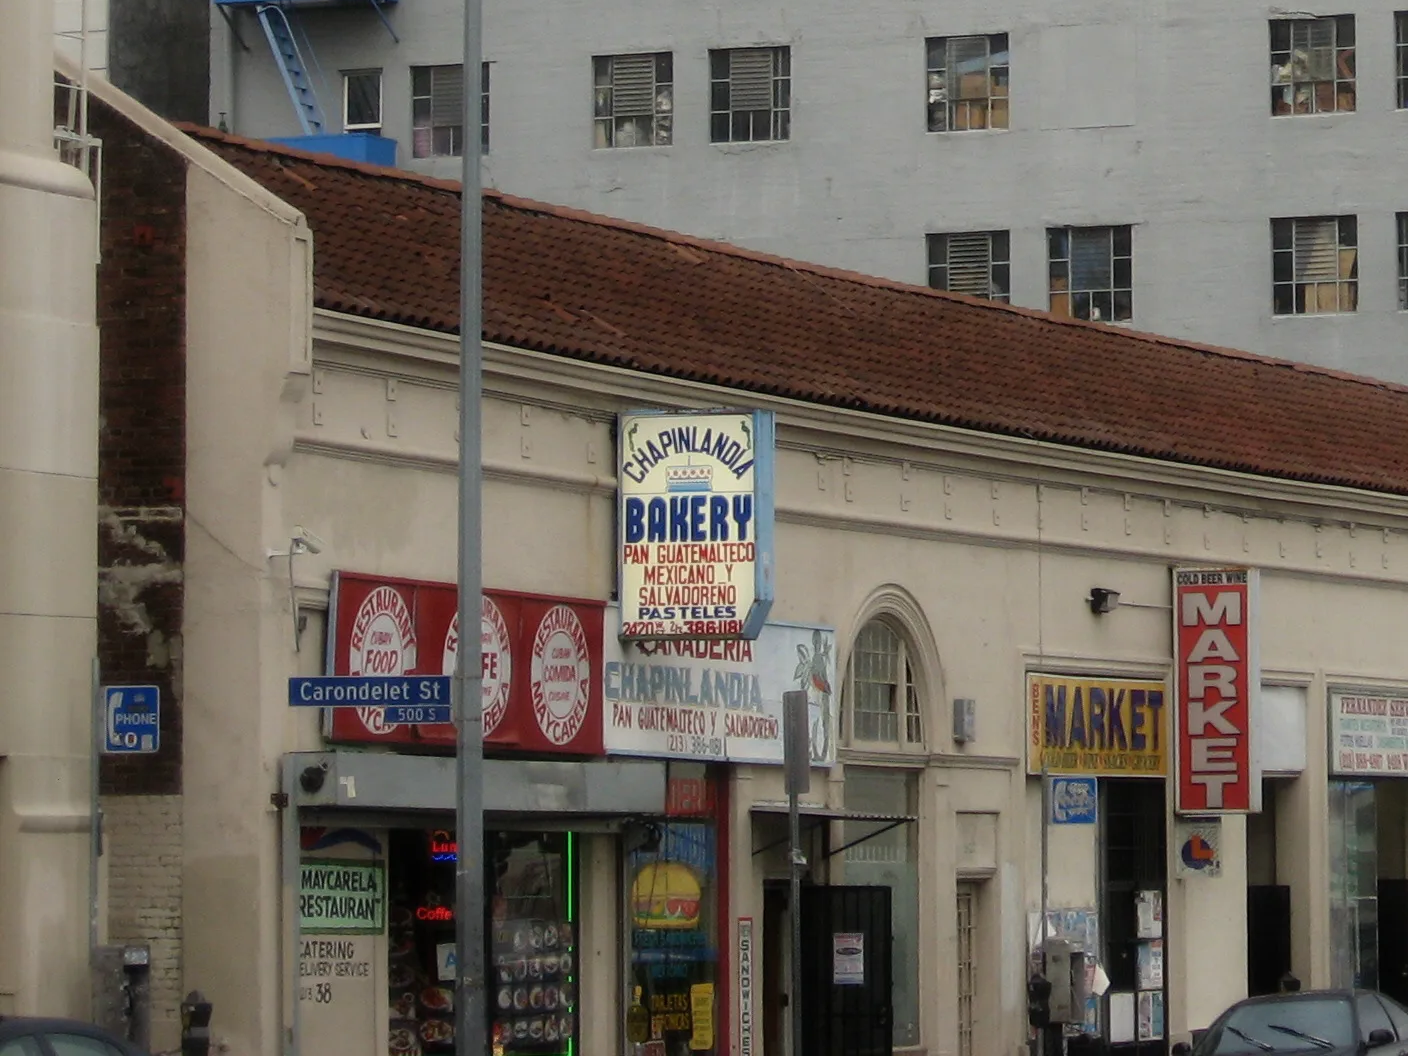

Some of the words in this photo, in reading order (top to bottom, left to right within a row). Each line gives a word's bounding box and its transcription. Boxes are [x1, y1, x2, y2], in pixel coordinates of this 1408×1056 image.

[625, 494, 752, 544] BAKERY
[623, 544, 649, 564] PAN
[657, 542, 755, 563] GUATEMALTECO
[644, 565, 715, 585] MEXICANO
[1177, 572, 1199, 585] COLD
[1201, 572, 1223, 585] BEER
[1226, 571, 1247, 584] WINE
[352, 587, 417, 653] RESTAURANT
[638, 606, 736, 619] PASTELES
[534, 607, 588, 662] RESTAURANT
[623, 622, 653, 636] 2420
[365, 649, 398, 675] FOOD
[300, 681, 410, 701] Carondelet
[419, 682, 440, 700] St
[1181, 592, 1241, 808] MARKET
[115, 713, 157, 725] PHONE
[398, 707, 424, 721] 500
[428, 707, 436, 721] S
[532, 678, 589, 742] MAYCARELA
[612, 704, 632, 728] PAN
[638, 707, 705, 735] GUATEMALTECO
[710, 712, 717, 735] Y
[1044, 684, 1164, 752] MARKET
[301, 869, 378, 893] MAYCARELA
[334, 961, 369, 977] SERVICE
